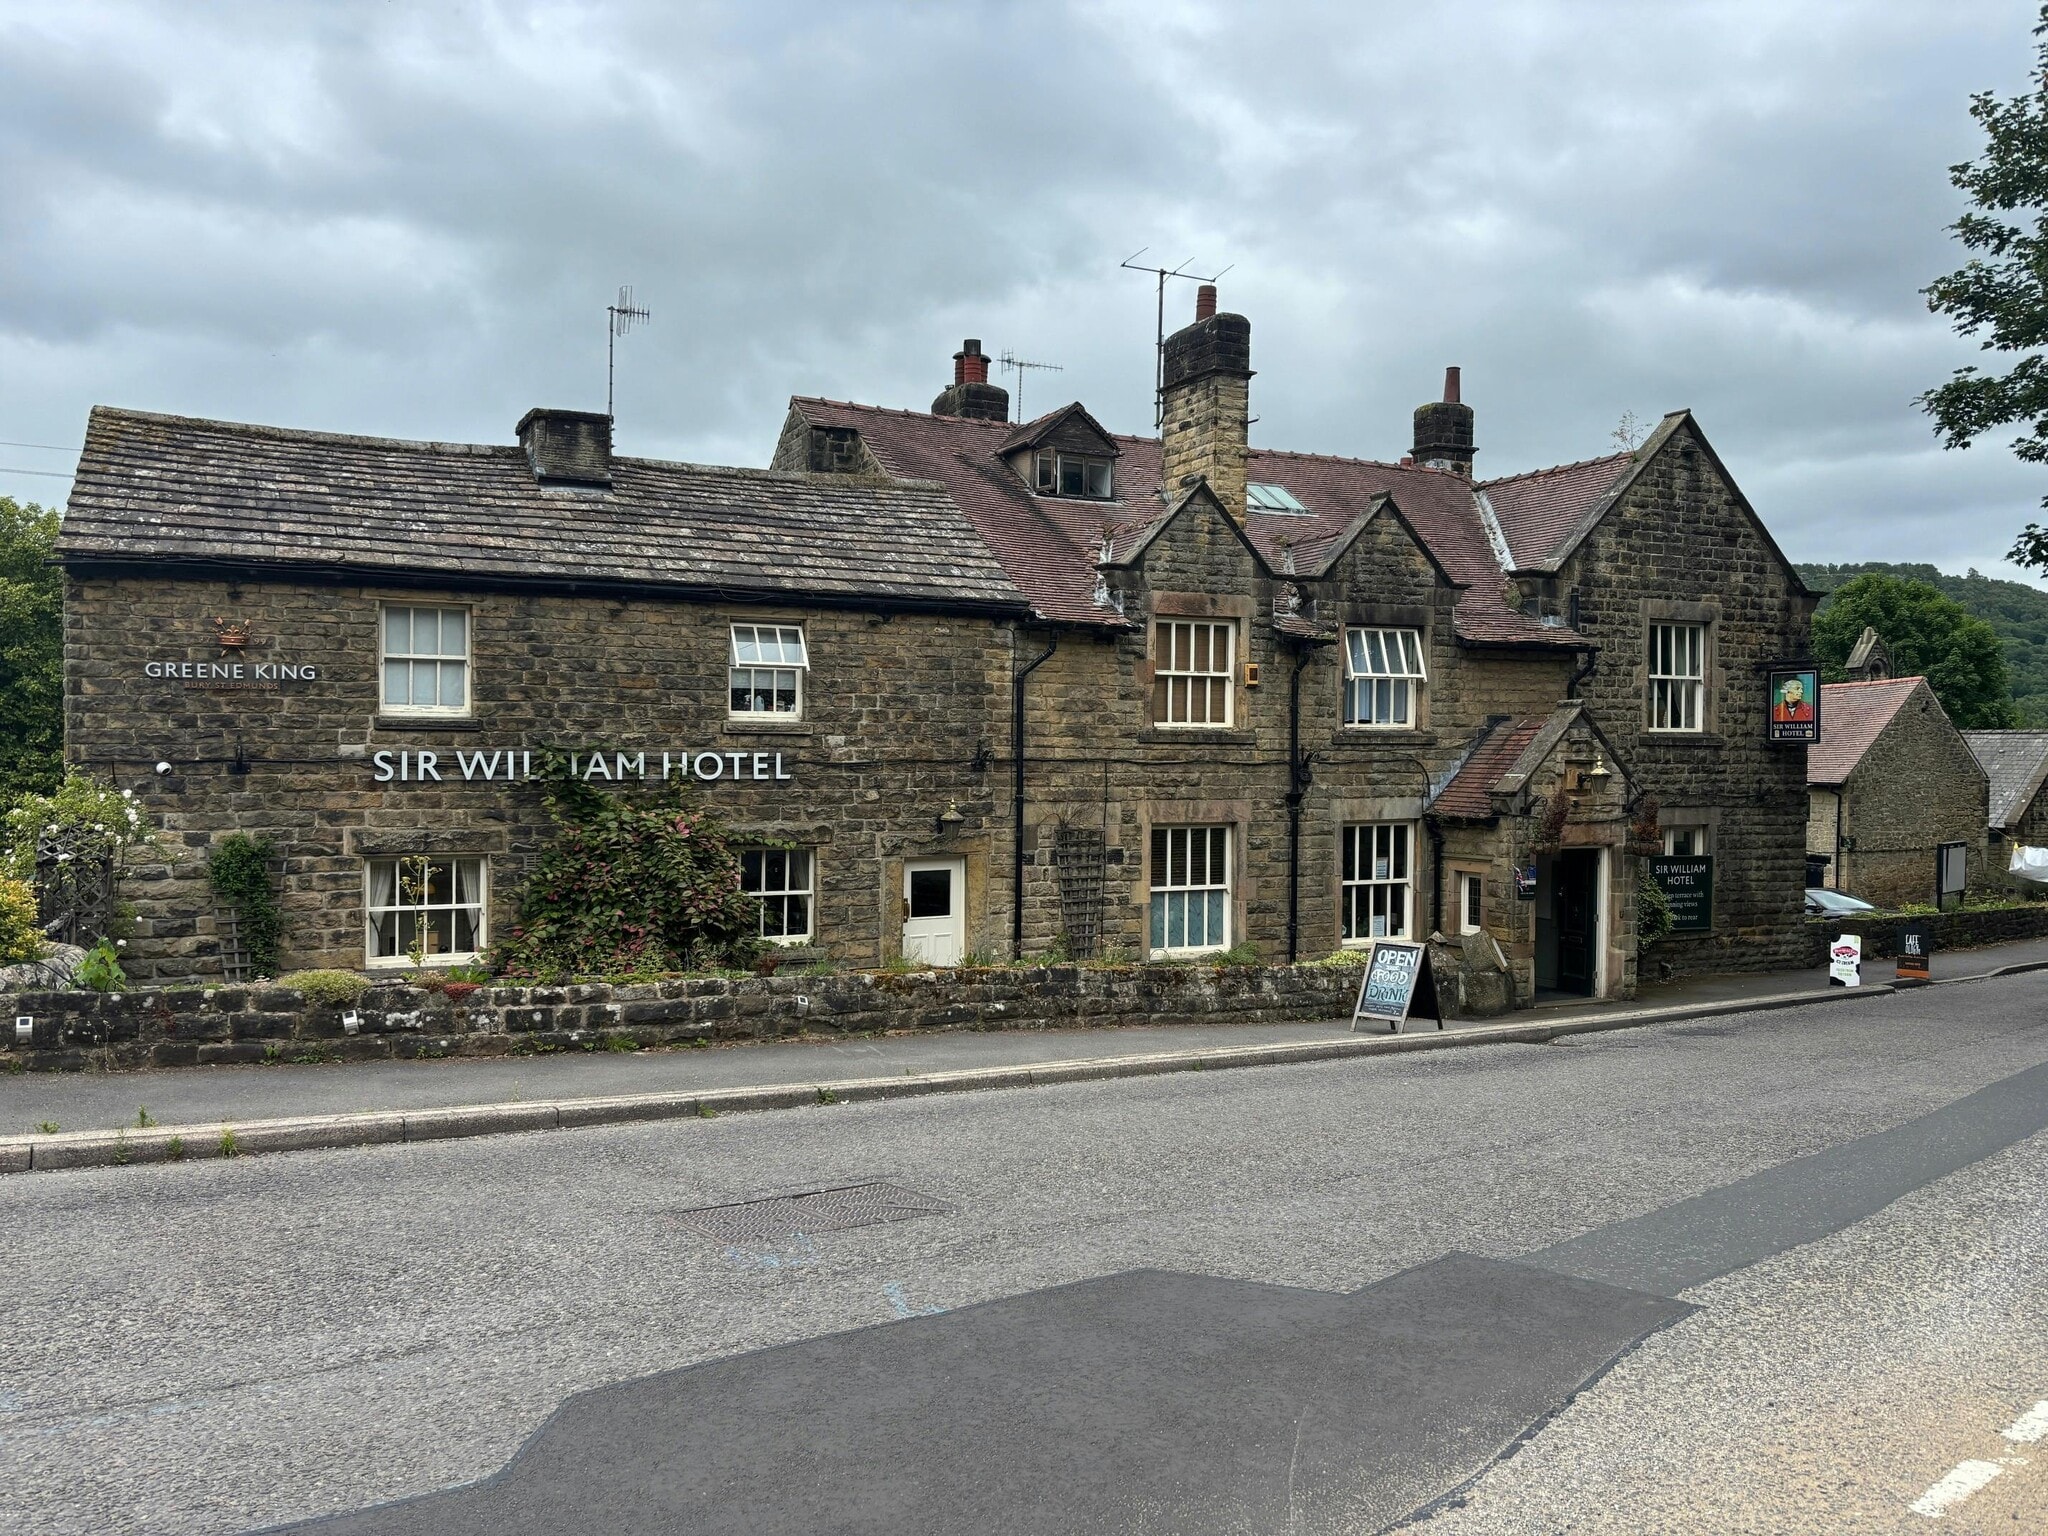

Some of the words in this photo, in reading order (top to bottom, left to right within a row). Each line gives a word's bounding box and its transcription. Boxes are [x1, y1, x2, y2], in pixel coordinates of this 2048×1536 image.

[145, 662, 244, 679] GREENE
[255, 664, 316, 680] KING
[184, 681, 211, 689] BURY
[230, 681, 279, 690] EDMUNDS
[373, 750, 442, 781] SIR
[456, 751, 645, 781] WILIAM
[663, 751, 792, 781] HOTEL
[1656, 866, 1668, 874] SIR
[1670, 864, 1706, 874] WILLIAM
[1668, 876, 1694, 884] HOTEL
[1378, 950, 1418, 966] OPEN
[1371, 969, 1409, 985] FOOD
